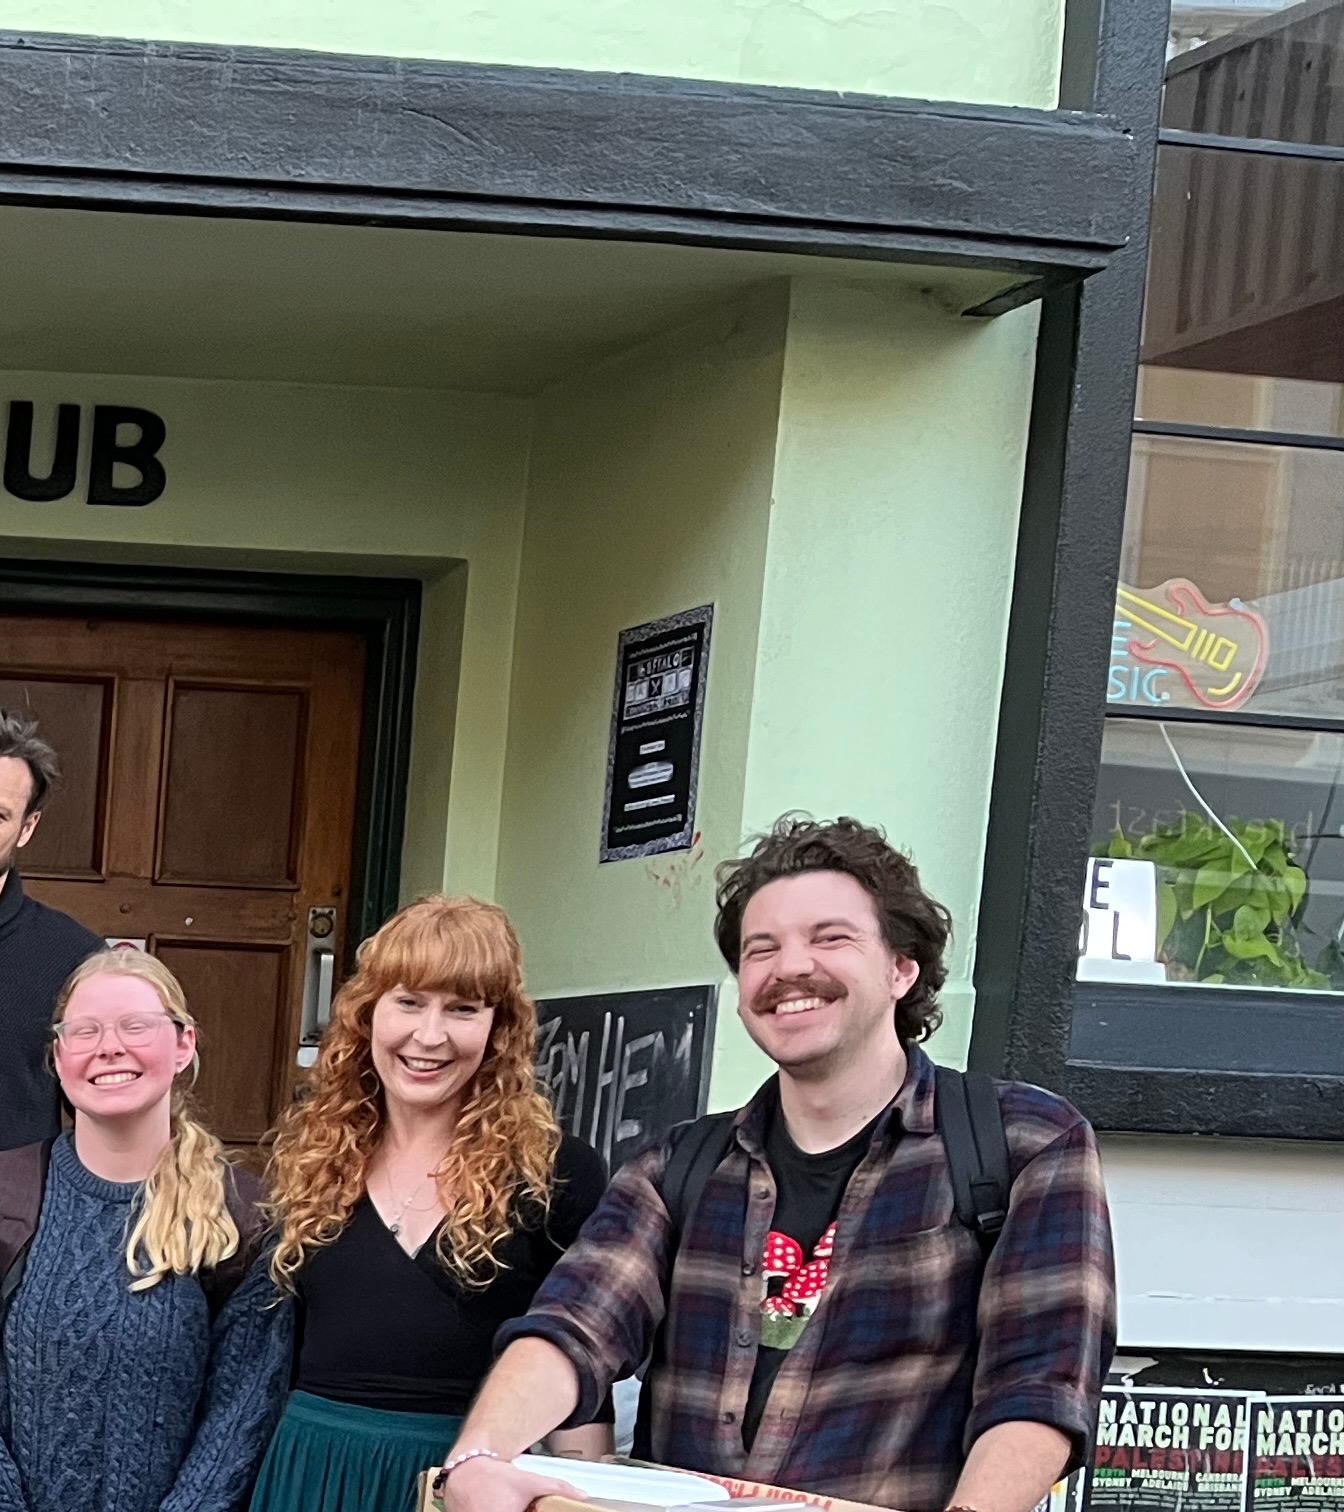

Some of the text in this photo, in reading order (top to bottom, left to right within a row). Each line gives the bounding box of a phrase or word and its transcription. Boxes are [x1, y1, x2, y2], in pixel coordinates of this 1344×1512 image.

[1099, 1400, 1247, 1427] NATIONAL
[1097, 1423, 1189, 1449] MARCH
[1257, 1432, 1344, 1456] MARCH
